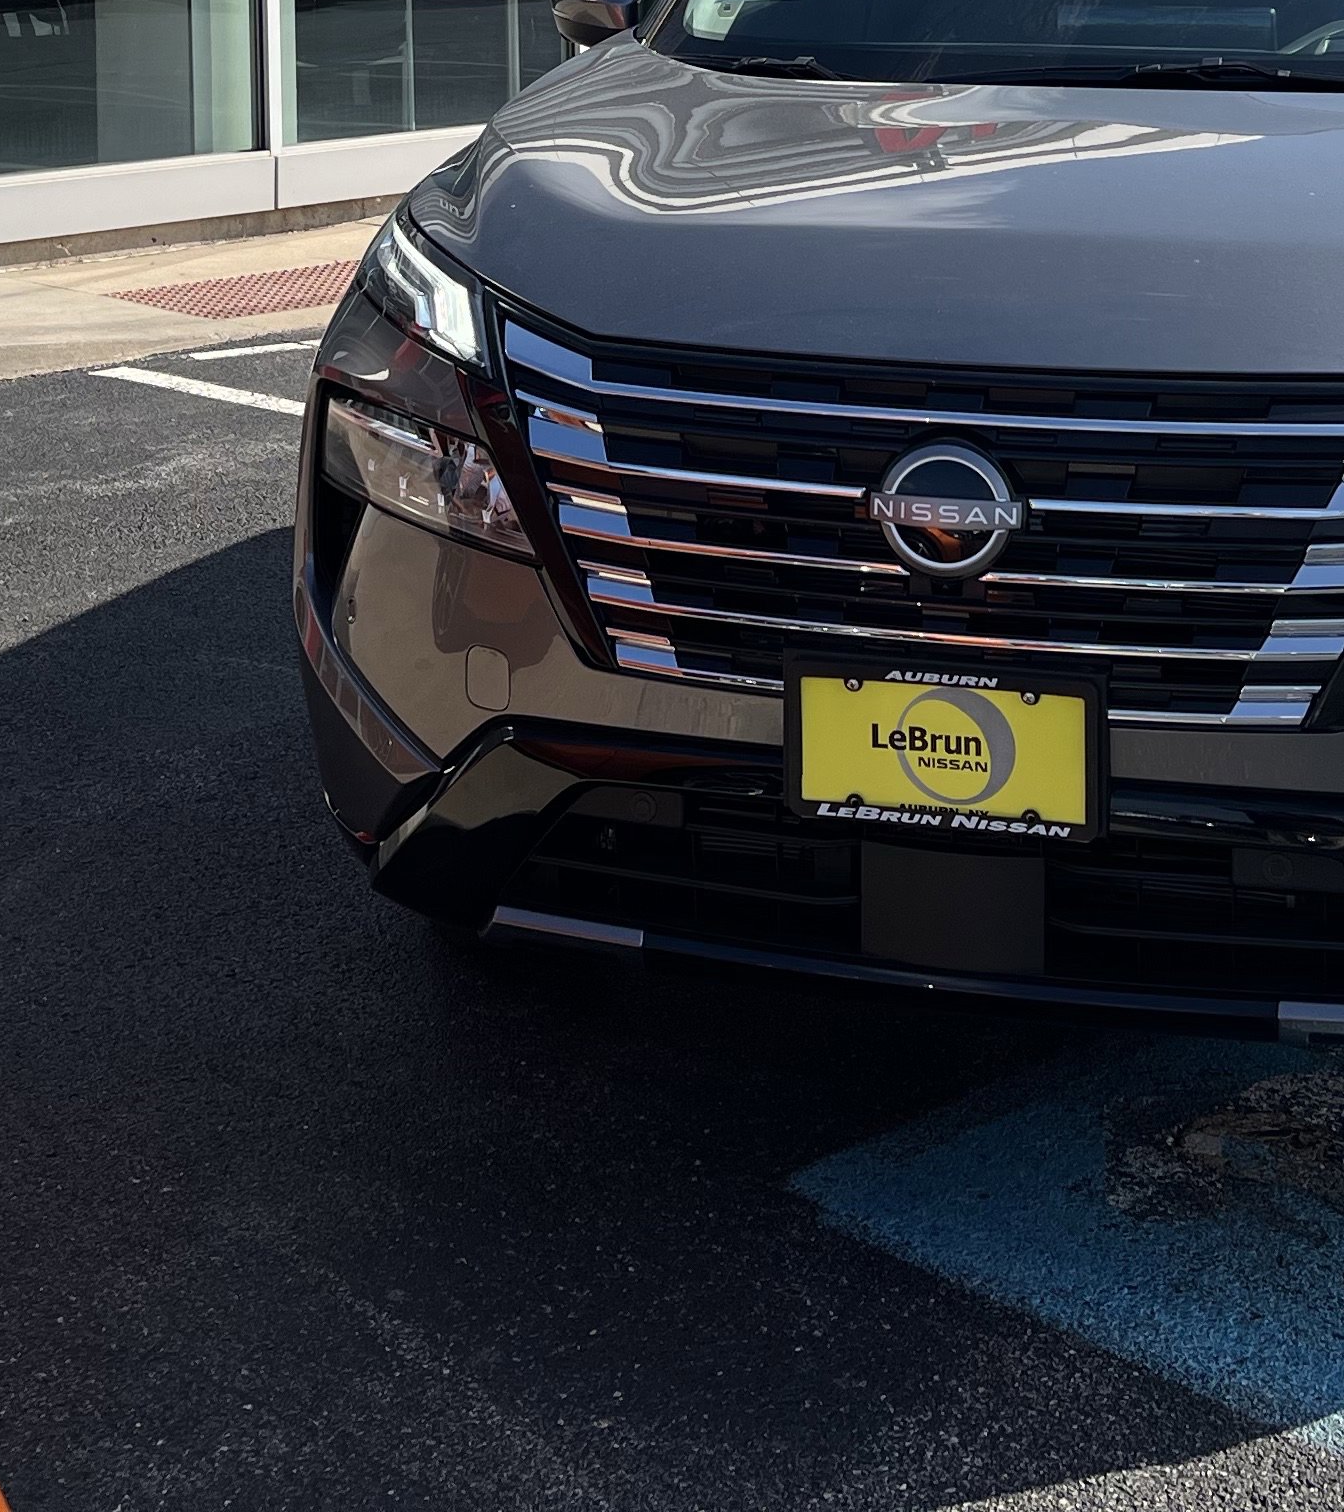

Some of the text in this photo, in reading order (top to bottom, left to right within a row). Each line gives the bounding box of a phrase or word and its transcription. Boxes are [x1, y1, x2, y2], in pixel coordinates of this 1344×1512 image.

[873, 497, 1018, 526] NISSAN
[884, 670, 999, 688] AUBURN
[871, 723, 982, 757] LeBrun
[917, 756, 988, 773] NISSAN
[950, 814, 1071, 838] NISSAN
